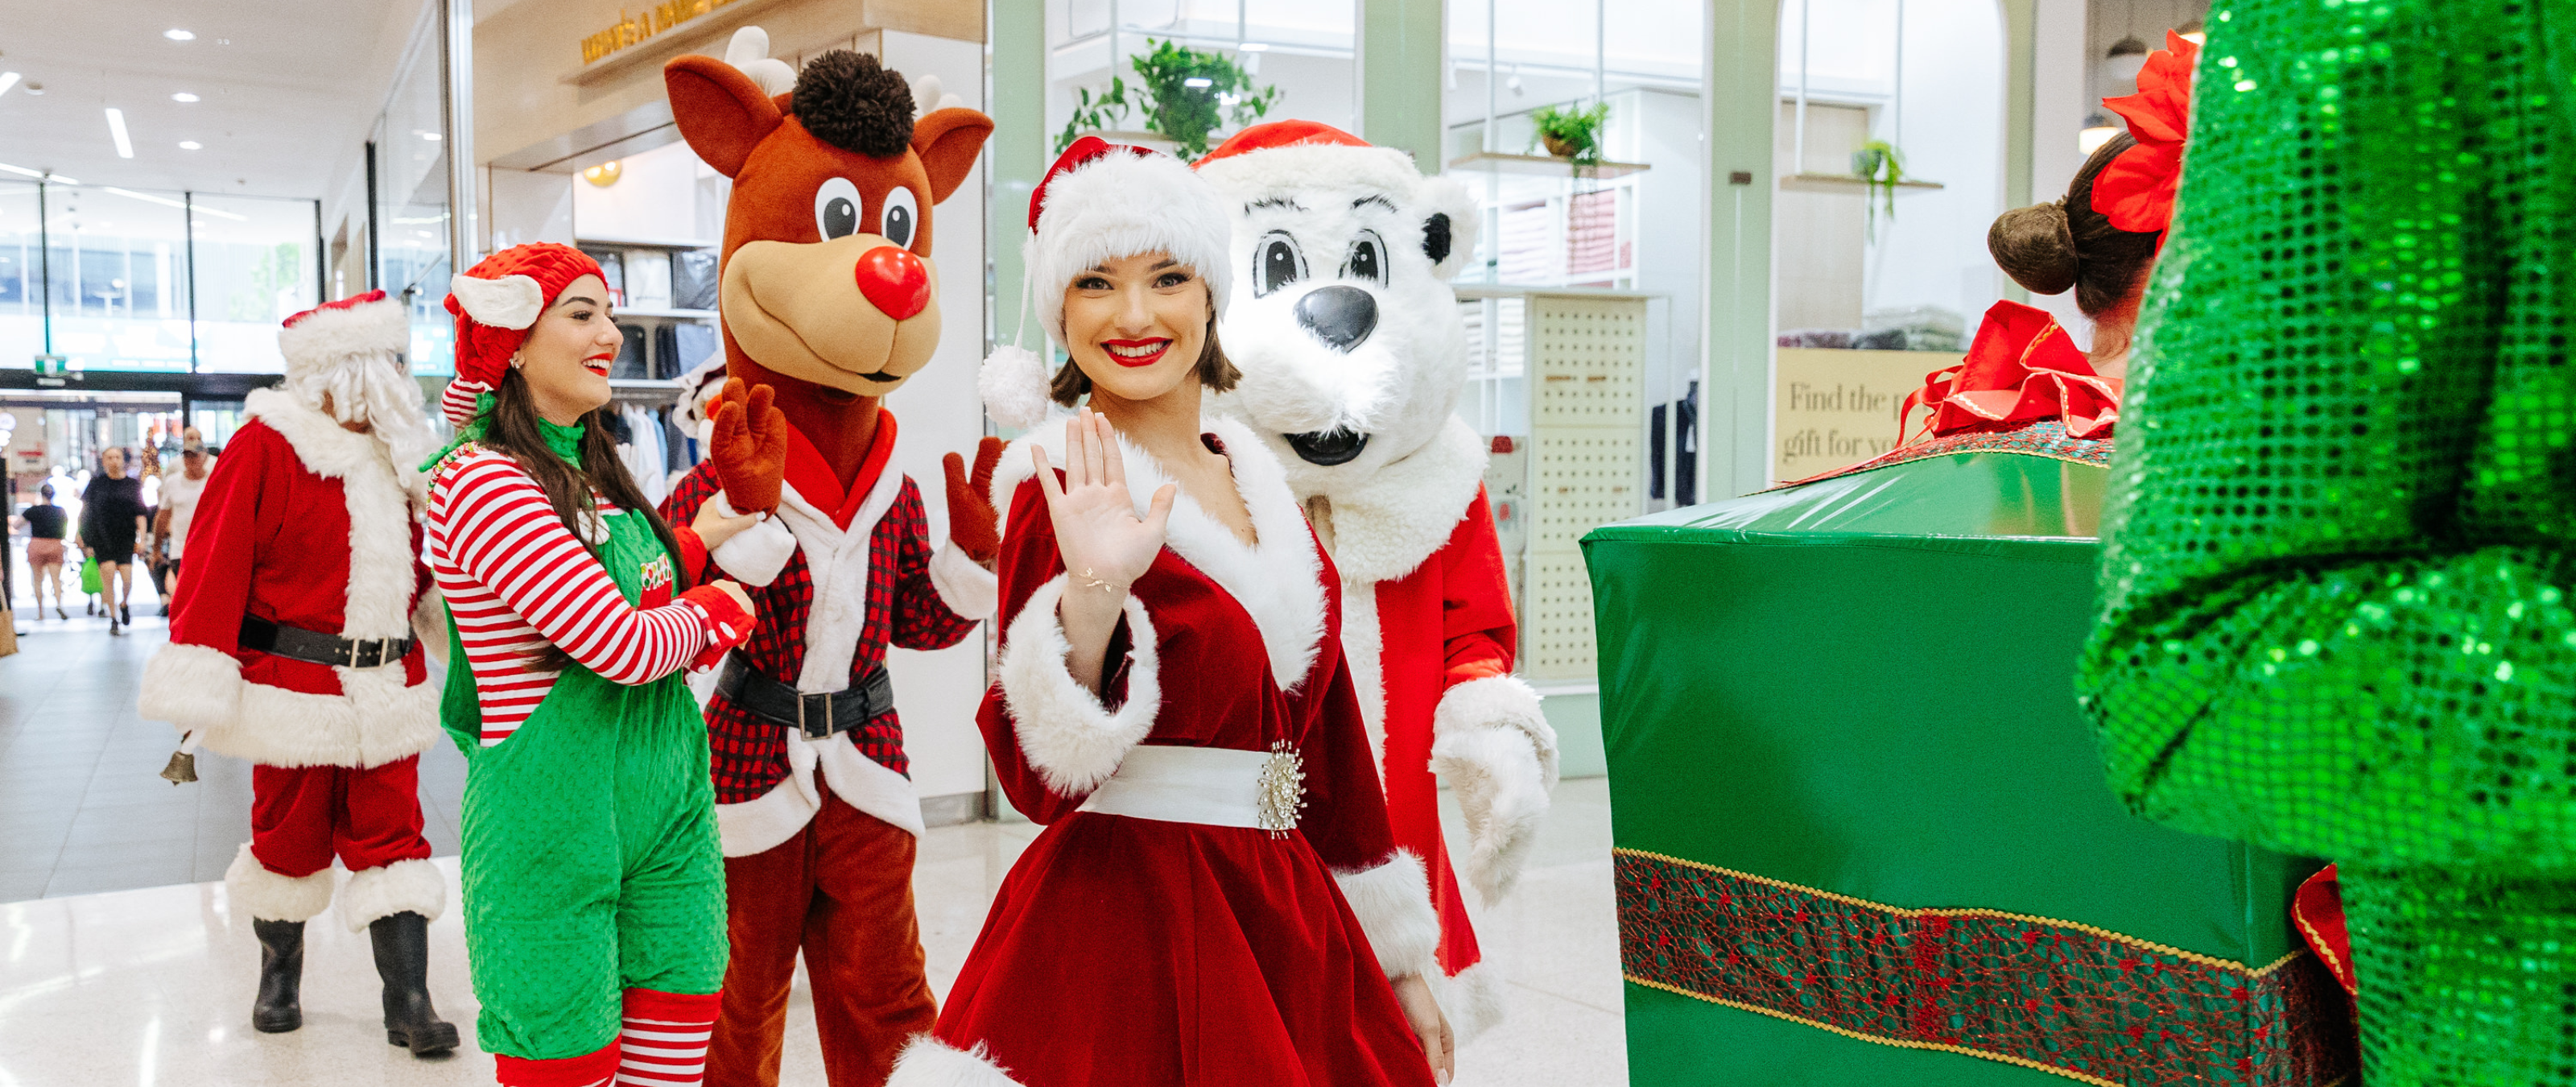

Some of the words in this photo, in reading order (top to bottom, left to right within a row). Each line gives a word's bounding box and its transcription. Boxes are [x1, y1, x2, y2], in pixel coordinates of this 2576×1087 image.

[1790, 381, 1843, 411] Find
[1849, 382, 1887, 412] the
[1782, 427, 1821, 465] gift
[1827, 428, 1864, 458] for
